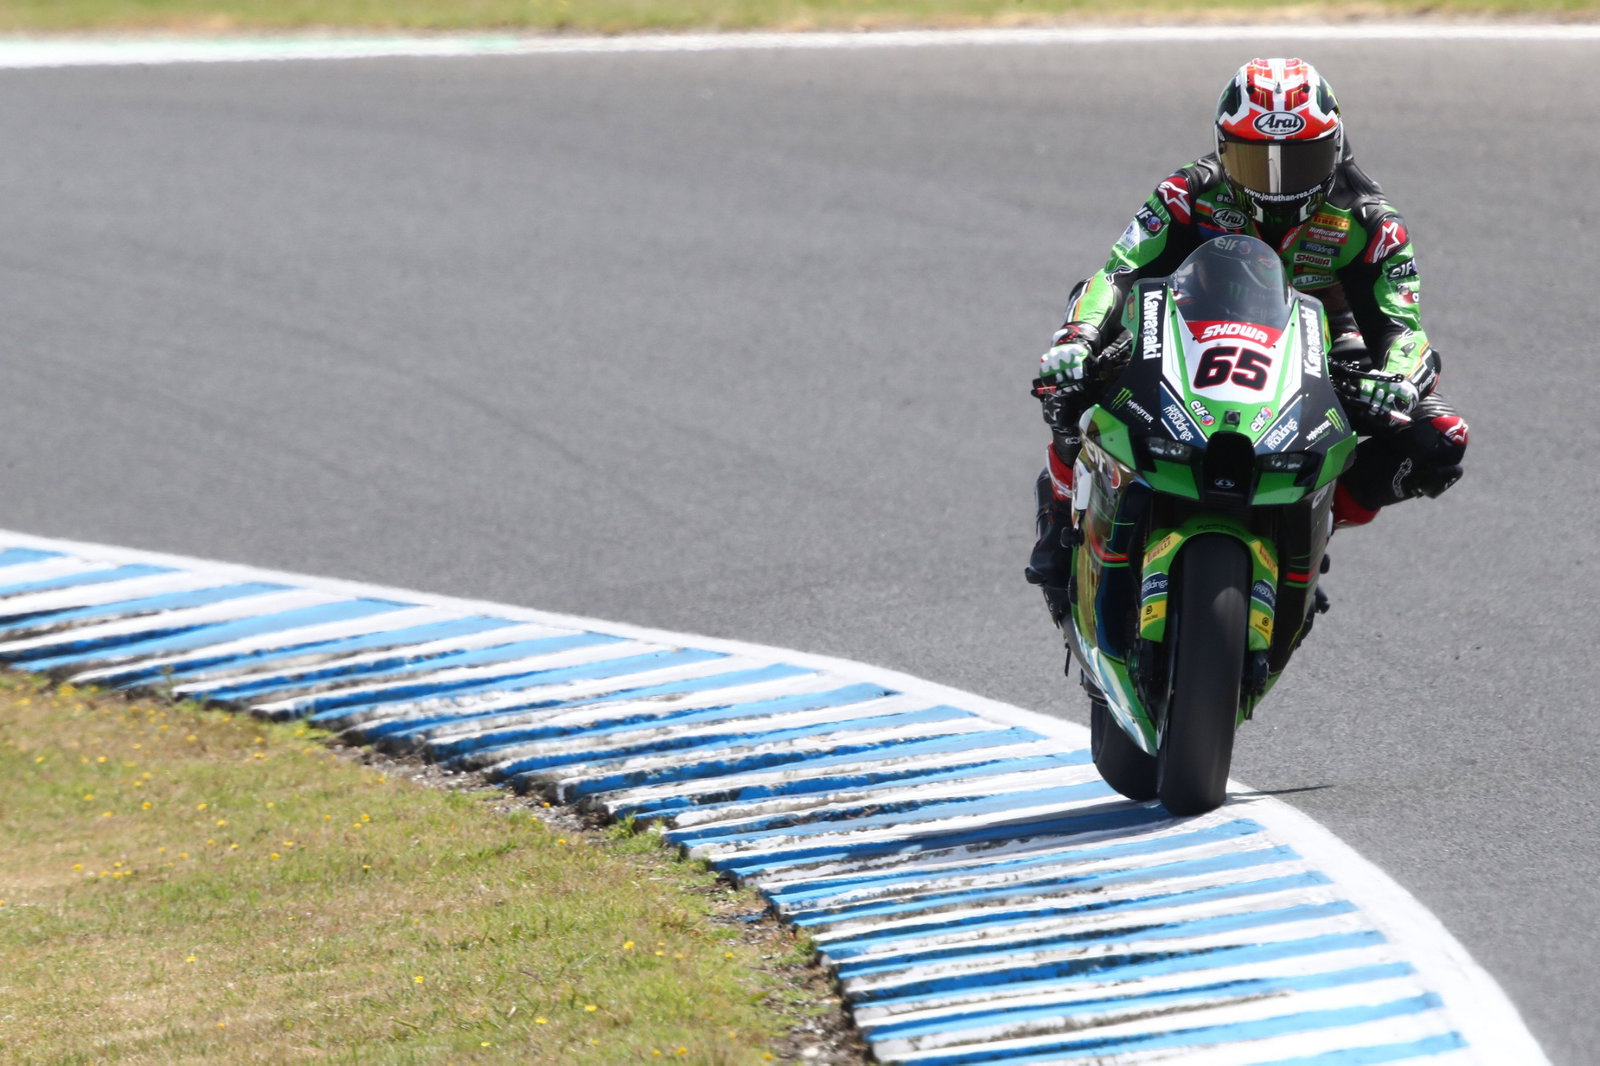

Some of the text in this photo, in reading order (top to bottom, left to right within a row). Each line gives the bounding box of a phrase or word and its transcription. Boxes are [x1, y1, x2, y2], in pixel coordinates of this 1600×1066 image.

[1258, 113, 1299, 129] Arai
[1244, 184, 1322, 201] www.jonathan-rea.com
[1214, 210, 1242, 226] Arai
[1214, 236, 1239, 250] elf
[1296, 254, 1330, 266] SHOWA
[1143, 290, 1162, 360] Kawasaki
[1201, 323, 1269, 343] SHOWA
[1193, 346, 1273, 391] 65
[1189, 400, 1208, 419] elf
[1163, 405, 1195, 442] mouldings
[1250, 412, 1266, 433] elf
